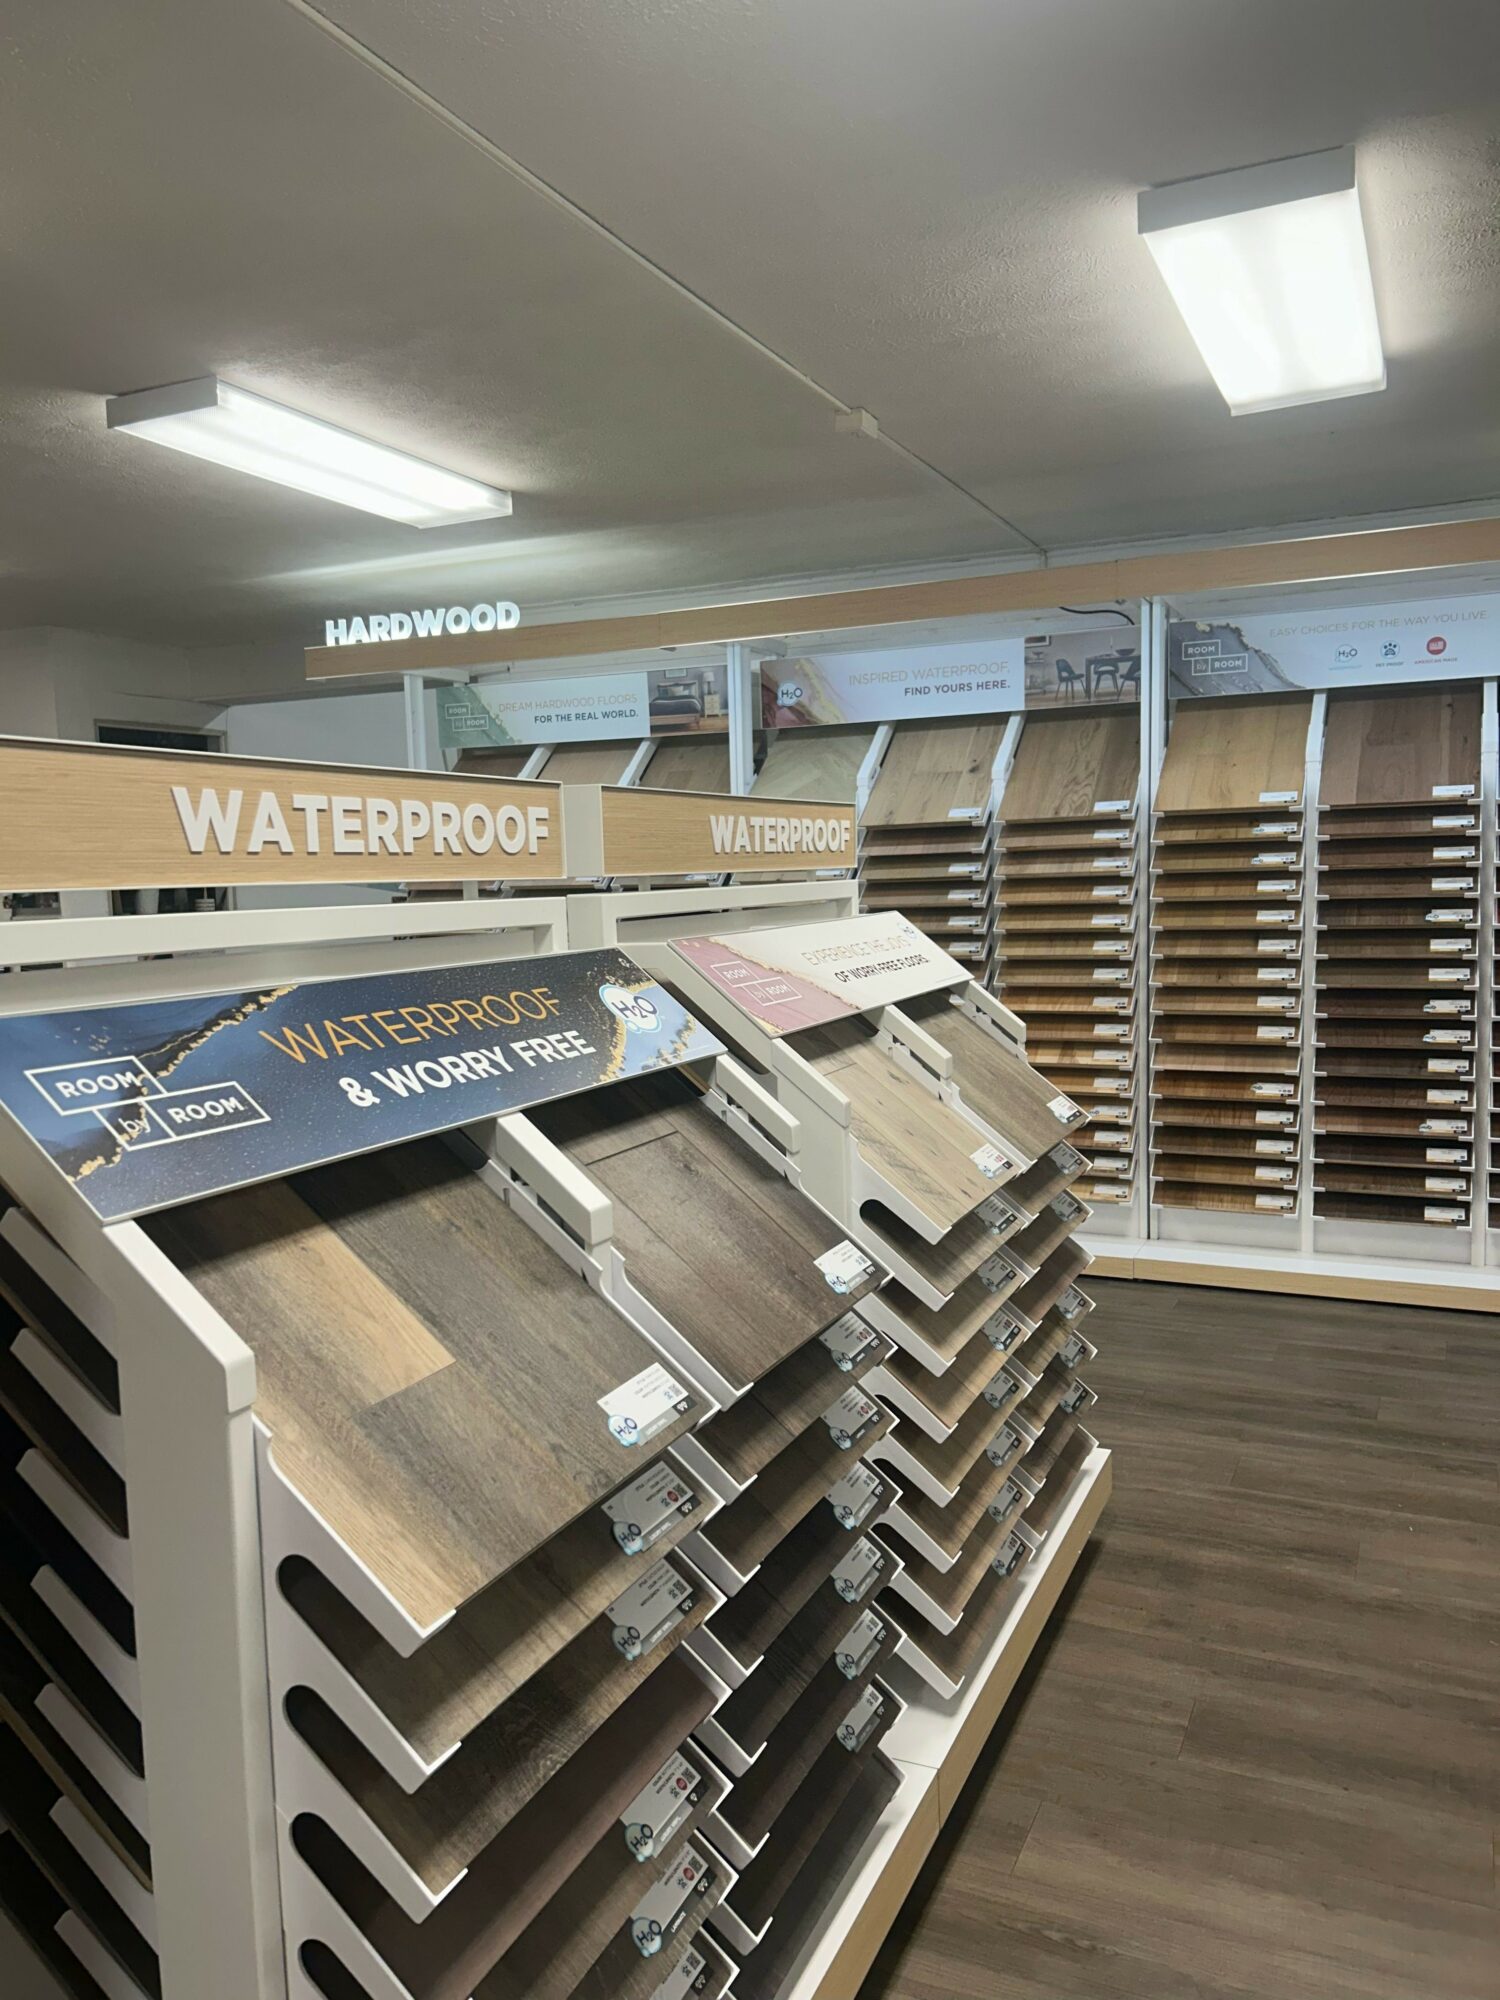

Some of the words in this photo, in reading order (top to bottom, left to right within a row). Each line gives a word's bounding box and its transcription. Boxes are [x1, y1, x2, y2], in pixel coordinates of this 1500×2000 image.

[325, 601, 521, 647] HARDWOOD
[1269, 627, 1297, 638] EASY
[1301, 623, 1348, 635] CHOICES
[1352, 620, 1375, 630] FOR
[1379, 618, 1401, 628] THE
[1404, 615, 1430, 626] WAY
[1433, 612, 1459, 623] YOU
[1461, 609, 1488, 621] LIVE
[1187, 646, 1215, 654] ROOM
[1215, 659, 1242, 668] ROOM
[848, 670, 908, 686] INSPIRED
[904, 686, 931, 697] FIND
[934, 682, 973, 694] YOURS
[976, 679, 1011, 691] HERE.
[499, 702, 533, 713] DREAM
[535, 696, 596, 710] HARDWOOD
[597, 693, 638, 706] FLOORS
[781, 687, 803, 700] H2O
[534, 715, 553, 724] FOR
[555, 713, 573, 723] THE
[575, 712, 599, 722] REAL
[602, 709, 639, 720] WORLD.
[171, 786, 551, 855] WATERPROOF
[709, 814, 851, 855] WATERPROOF
[834, 970, 851, 983] OF
[611, 995, 657, 1022] H2O
[257, 987, 561, 1064] WATERPROOF
[338, 1076, 380, 1108] &
[371, 1047, 515, 1098] WORRY
[510, 1029, 597, 1068] FREE
[55, 1071, 142, 1098] ROOM
[118, 1117, 151, 1134] by
[167, 1096, 244, 1124] ROOM
[630, 1824, 654, 1851] H2O
[636, 1920, 661, 1946] H2O
